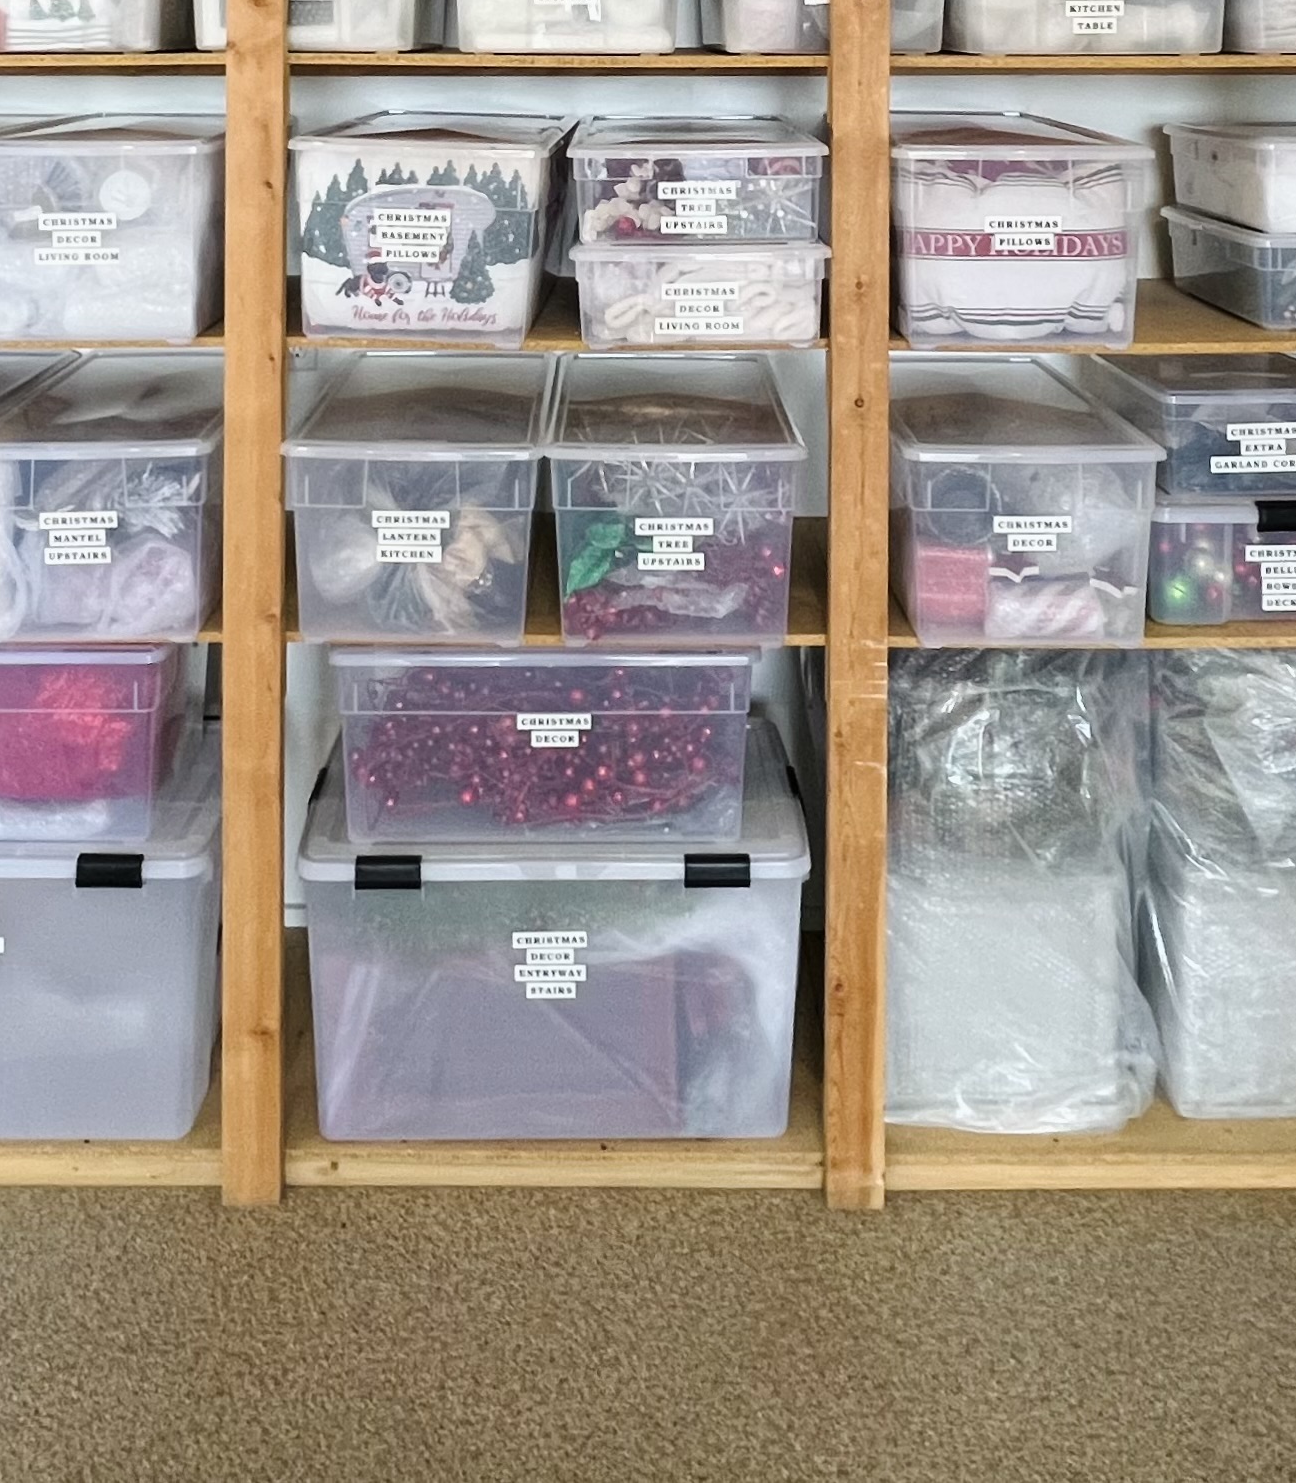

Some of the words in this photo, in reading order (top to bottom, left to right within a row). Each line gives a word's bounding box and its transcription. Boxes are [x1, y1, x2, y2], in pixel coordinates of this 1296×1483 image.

[1069, 4, 1121, 13] KITCHEN
[1077, 21, 1113, 30] TABLE
[662, 186, 732, 195] CHRISTMAS
[680, 204, 712, 212] TREE
[42, 217, 113, 226] CHRISTMAS
[378, 213, 447, 222] CHRISTMAS
[665, 221, 724, 229] UPSTAIRS
[988, 220, 1059, 229] CHRISTMAS
[56, 235, 97, 244] DECOR
[381, 232, 445, 240] BASEMENT
[999, 238, 1051, 246] PILLOWS
[38, 253, 79, 261] LIVING
[84, 252, 119, 261] ROOM
[385, 250, 438, 258] PILLOWS
[664, 287, 735, 296] CHRISTMAS
[679, 305, 720, 313] DECOR
[659, 322, 700, 331] LIVING
[705, 322, 740, 330] ROOM
[1245, 443, 1283, 452] EXTRA
[1214, 460, 1268, 469] GARLAND
[43, 516, 114, 525] CHRISTMAS
[376, 515, 446, 524] CHRISTMAS
[638, 523, 709, 531] CHRISTMAS
[997, 521, 1068, 529] CHRISTMAS
[53, 534, 101, 543] MANTEL
[382, 533, 437, 541] LANTERN
[658, 540, 689, 549] TREE
[1012, 539, 1053, 547] DECOR
[48, 551, 107, 560] UPSTAIRS
[380, 550, 434, 559] KITCHEN
[642, 557, 701, 566] UPSTAIRS
[1266, 599, 1296, 607] DECK
[521, 718, 589, 726] CHRISTMAS
[535, 735, 575, 743] DECOR
[516, 936, 586, 944] CHRISTMAS
[530, 952, 570, 961] DECOR
[518, 969, 582, 977] ENTRYWAY
[530, 986, 573, 995] STAIRS
